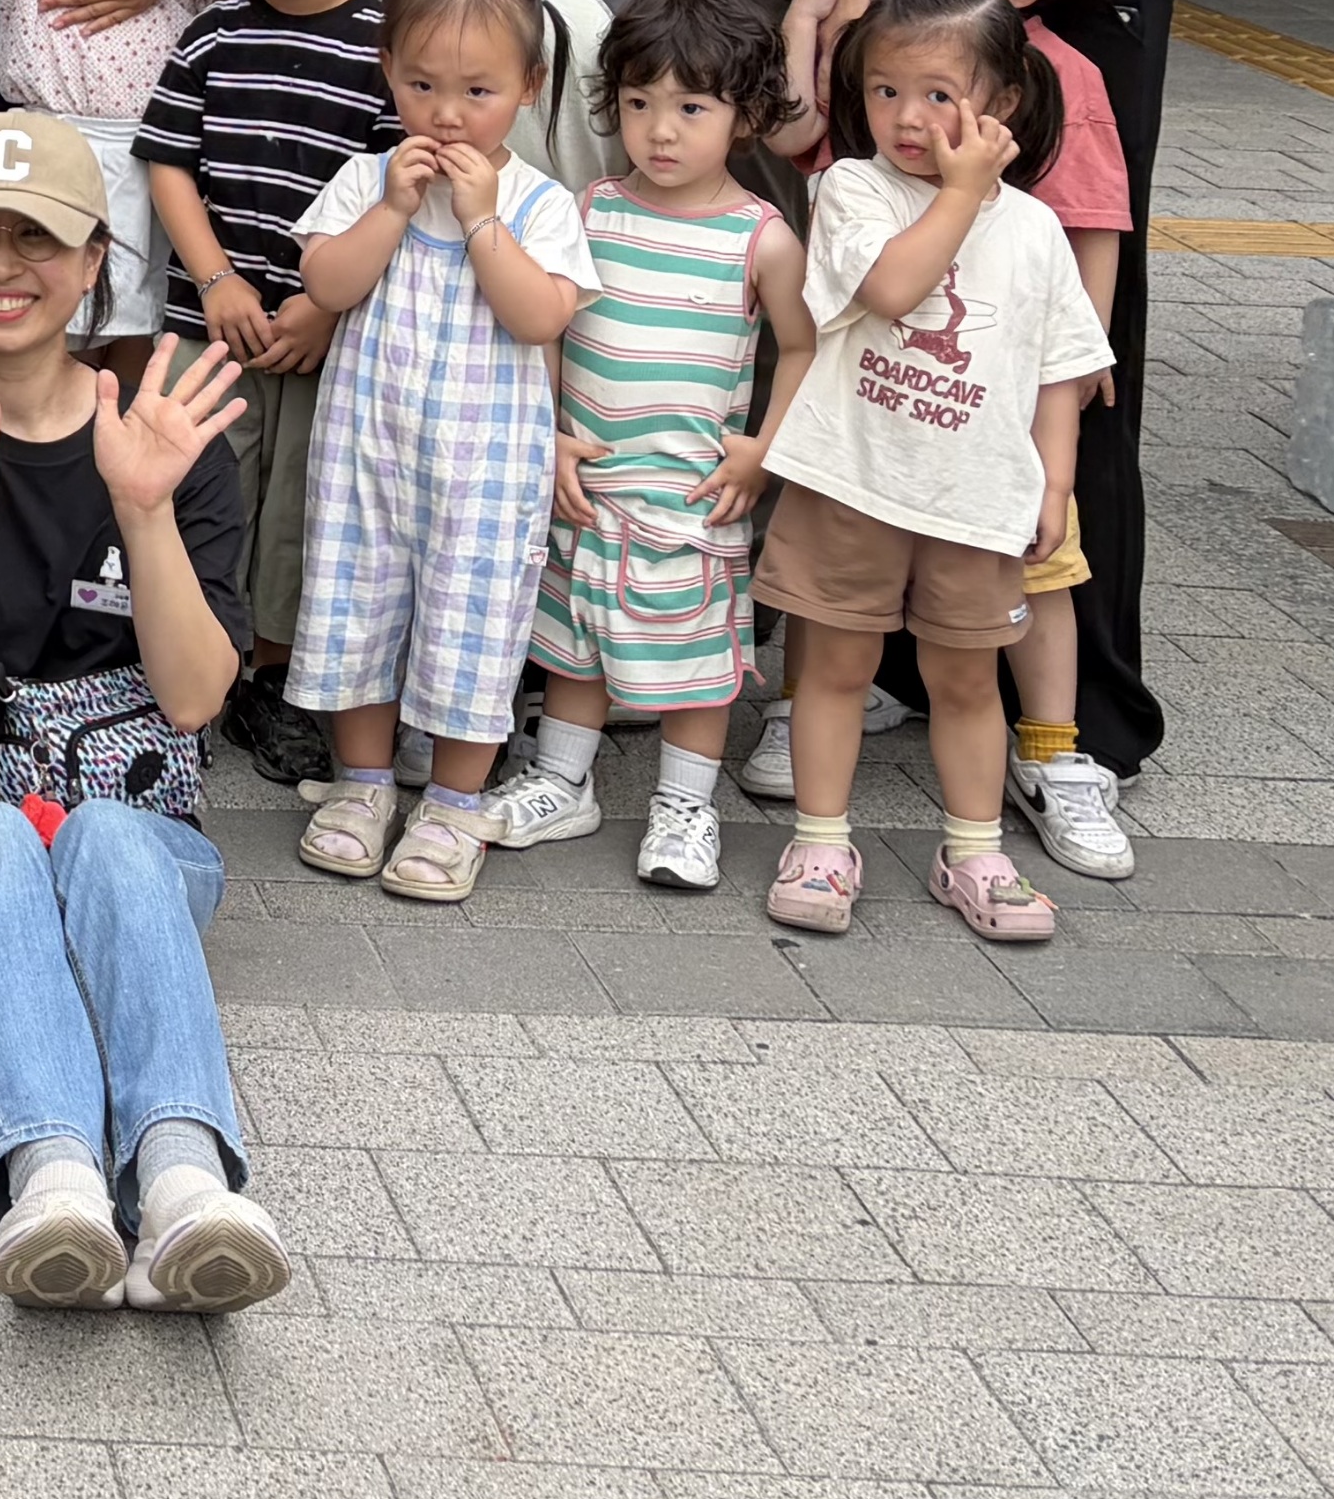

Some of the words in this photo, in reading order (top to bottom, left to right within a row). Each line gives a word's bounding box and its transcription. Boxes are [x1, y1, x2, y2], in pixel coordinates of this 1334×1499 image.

[856, 376, 909, 412] SURF
[909, 398, 970, 432] SHOP
[859, 348, 987, 408] BOARDCAVE
